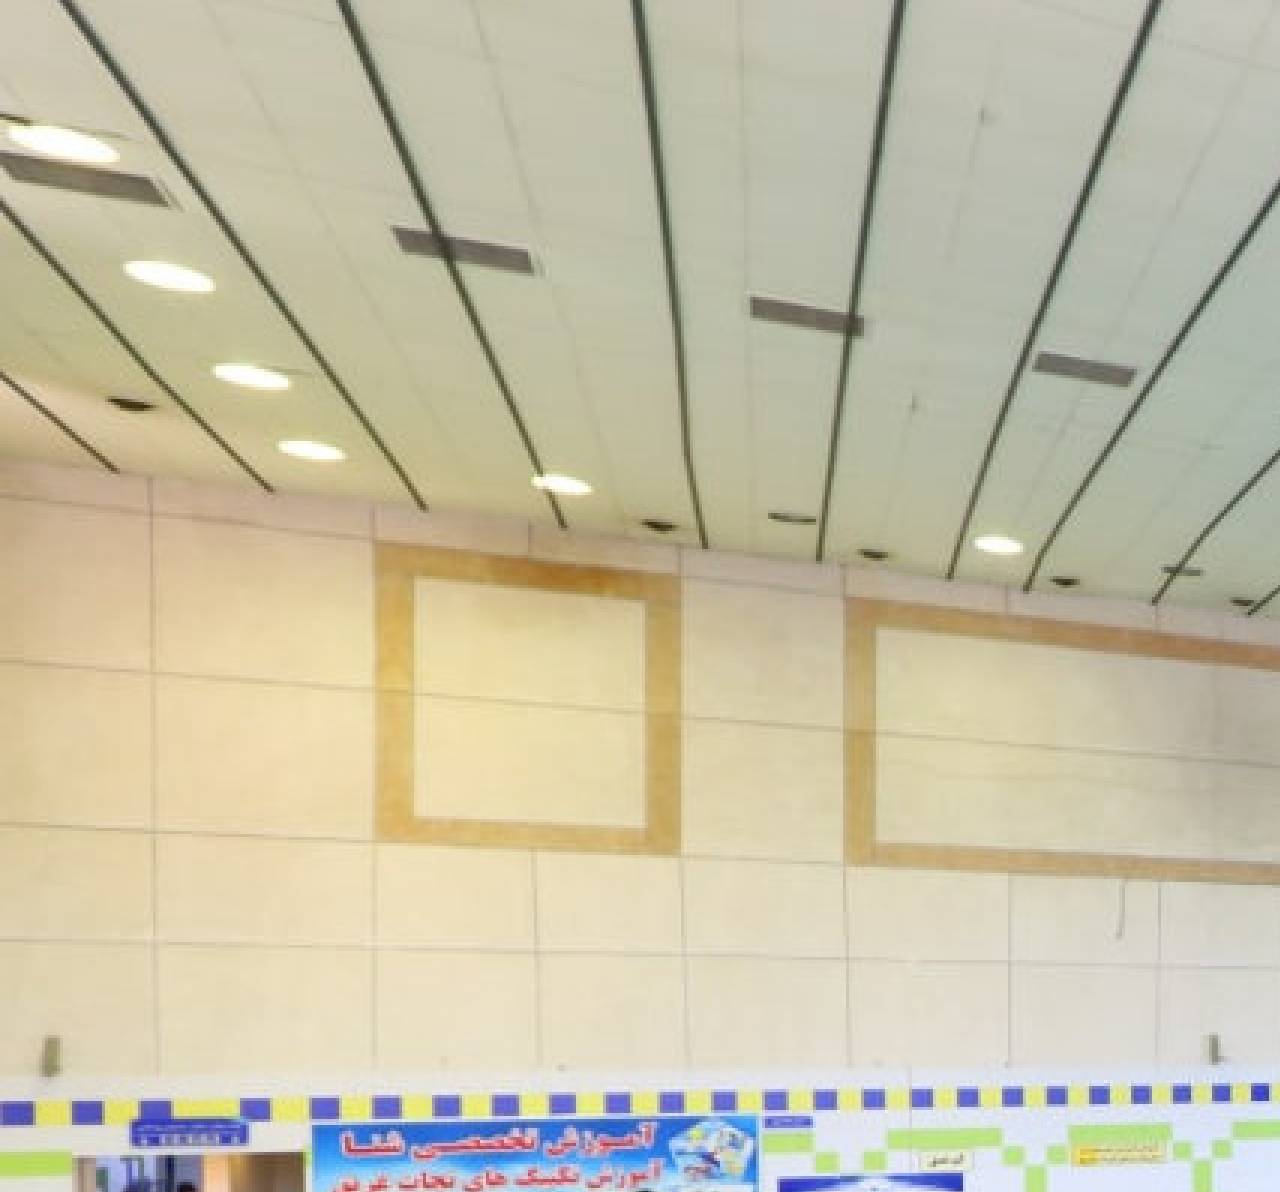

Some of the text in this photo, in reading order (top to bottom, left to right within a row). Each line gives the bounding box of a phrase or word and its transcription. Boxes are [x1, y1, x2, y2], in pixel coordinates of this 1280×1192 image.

[339, 1121, 659, 1162] آموزش تخصصی شنا
[398, 1168, 456, 1192] نجات
[514, 1163, 581, 1189] تکنیک
[585, 1157, 665, 1192] آموزش
